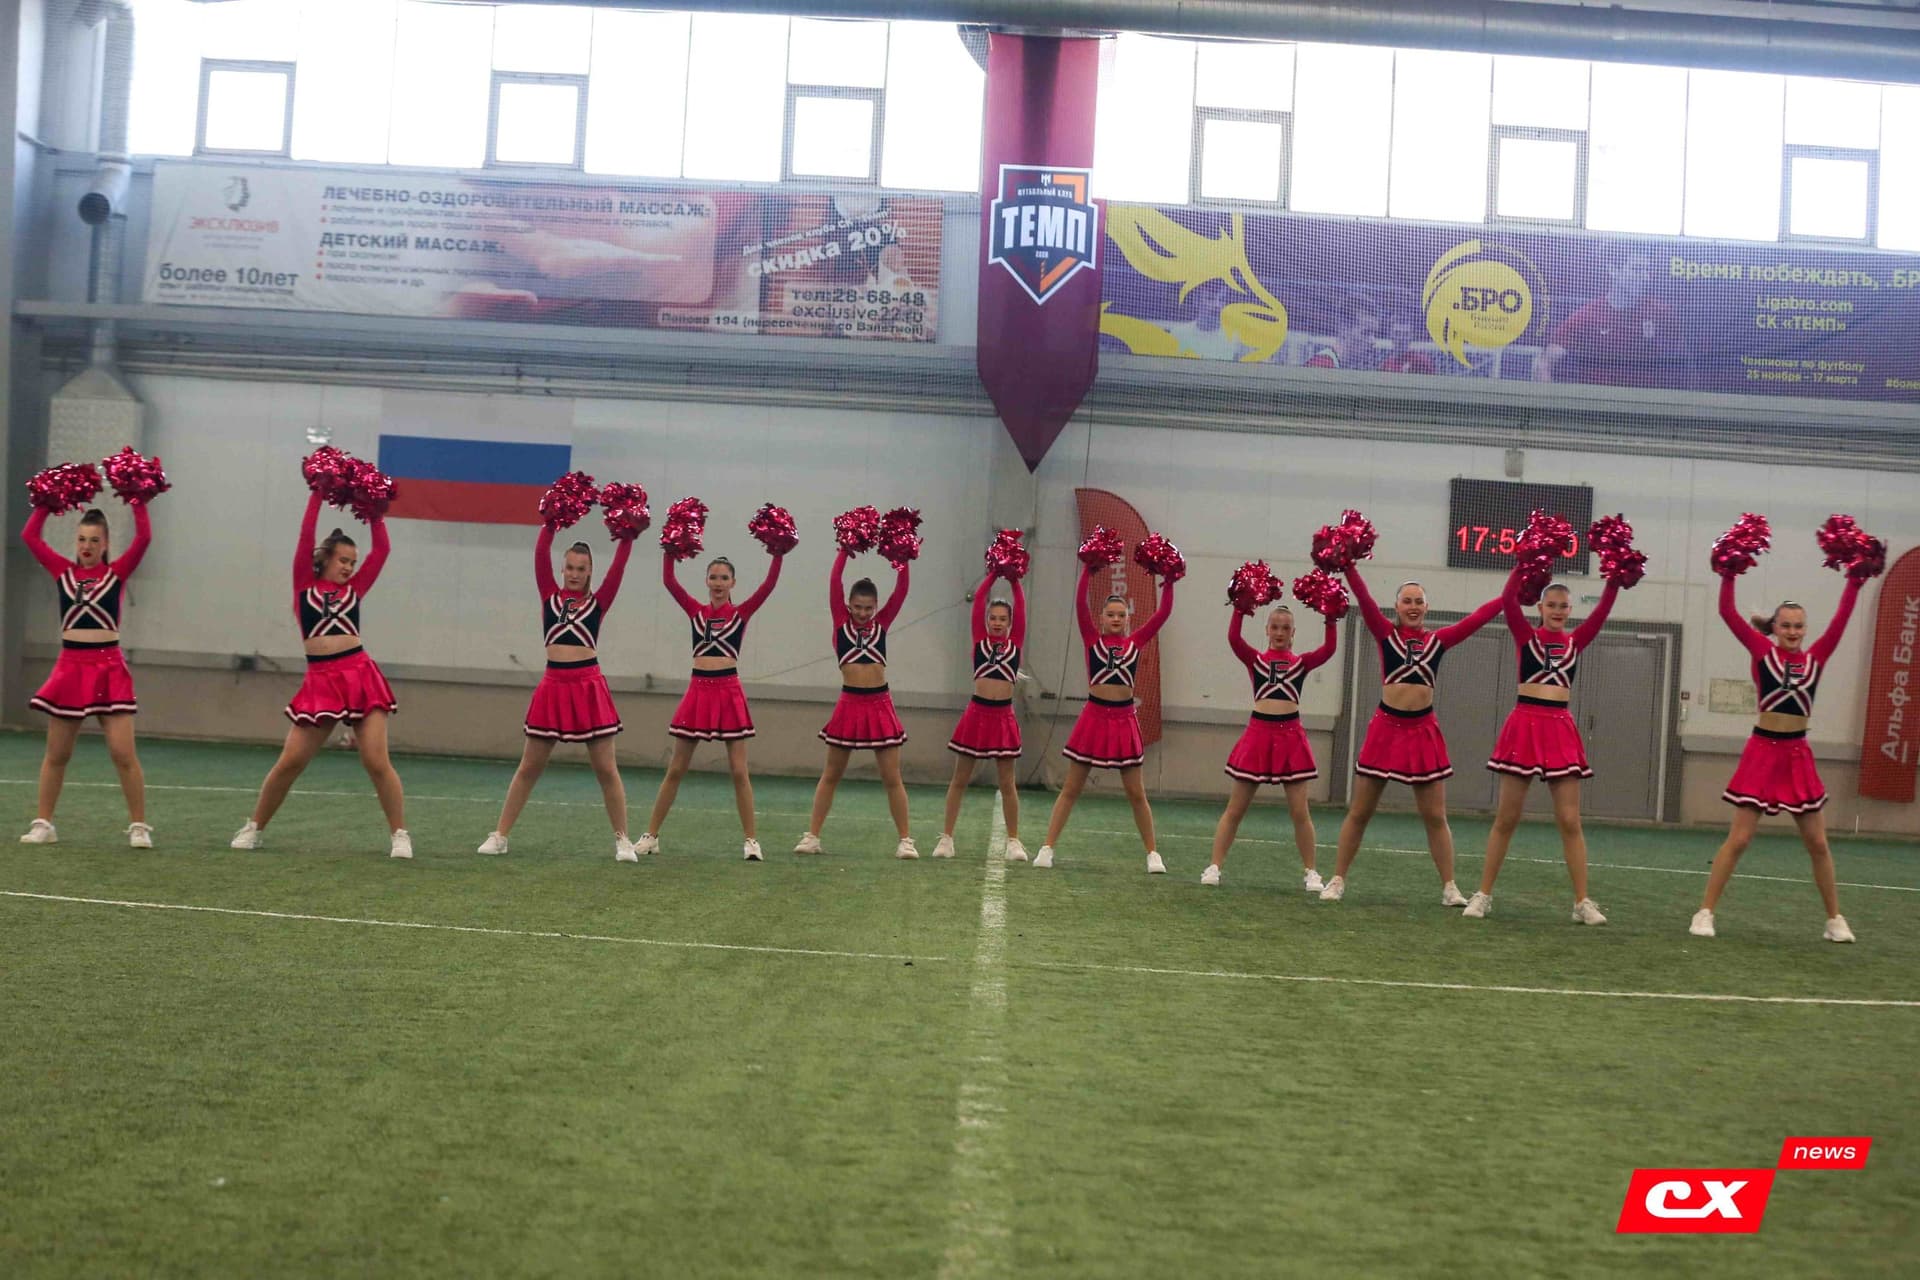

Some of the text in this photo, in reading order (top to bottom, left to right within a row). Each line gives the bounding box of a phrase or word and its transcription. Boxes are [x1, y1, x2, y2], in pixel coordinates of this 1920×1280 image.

[619, 200, 711, 217] МАССАЖ:
[847, 220, 907, 252] 20%
[1001, 205, 1087, 254] ТЕМП
[319, 232, 505, 253] ДЕТСКИЙ МАССАЖ:
[159, 262, 300, 287] более 10лет
[1670, 256, 1743, 283] Время
[1749, 262, 1880, 290] побеждать,
[792, 304, 924, 324] exclusive22.ru
[1756, 295, 1854, 313] Ligabro.com
[713, 315, 738, 326] 194
[1755, 314, 1847, 332] СК «ТЕМП»
[1818, 359, 1865, 373] футболу
[1761, 371, 1801, 383] ноября
[1824, 375, 1858, 386] марта
[1880, 595, 1920, 761] Альфа Банк
